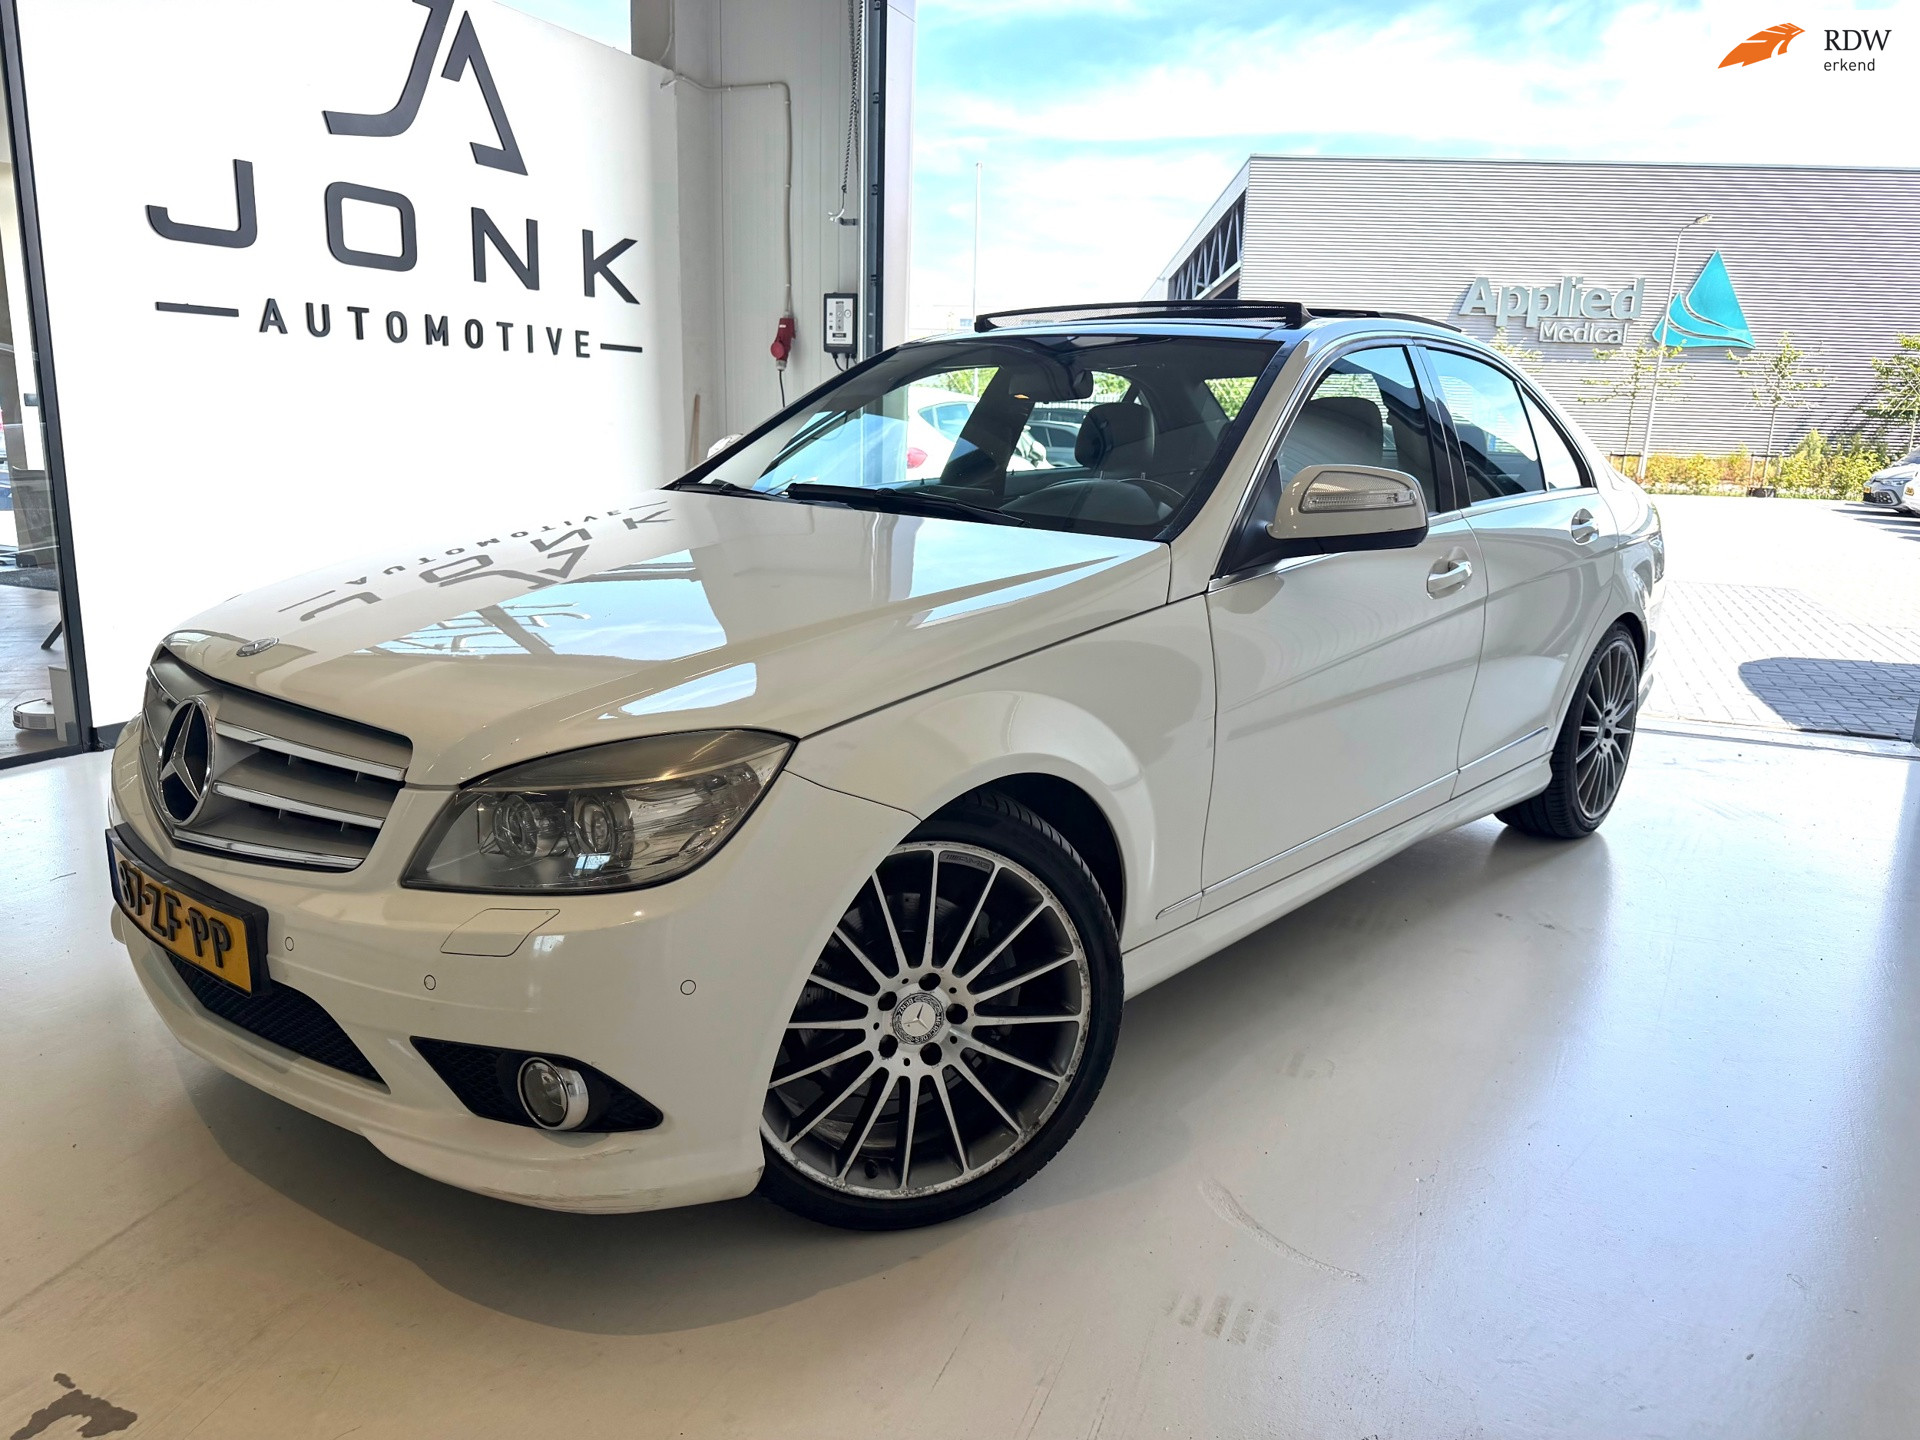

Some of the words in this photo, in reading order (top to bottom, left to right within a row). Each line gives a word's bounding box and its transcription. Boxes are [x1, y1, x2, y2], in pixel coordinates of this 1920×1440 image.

[146, 159, 641, 305] JONK
[259, 298, 591, 359] AUTOMOTIVE
[1459, 276, 1645, 327] Applied
[1539, 321, 1628, 344] Medical
[118, 860, 232, 969] 87-ZF-PP
